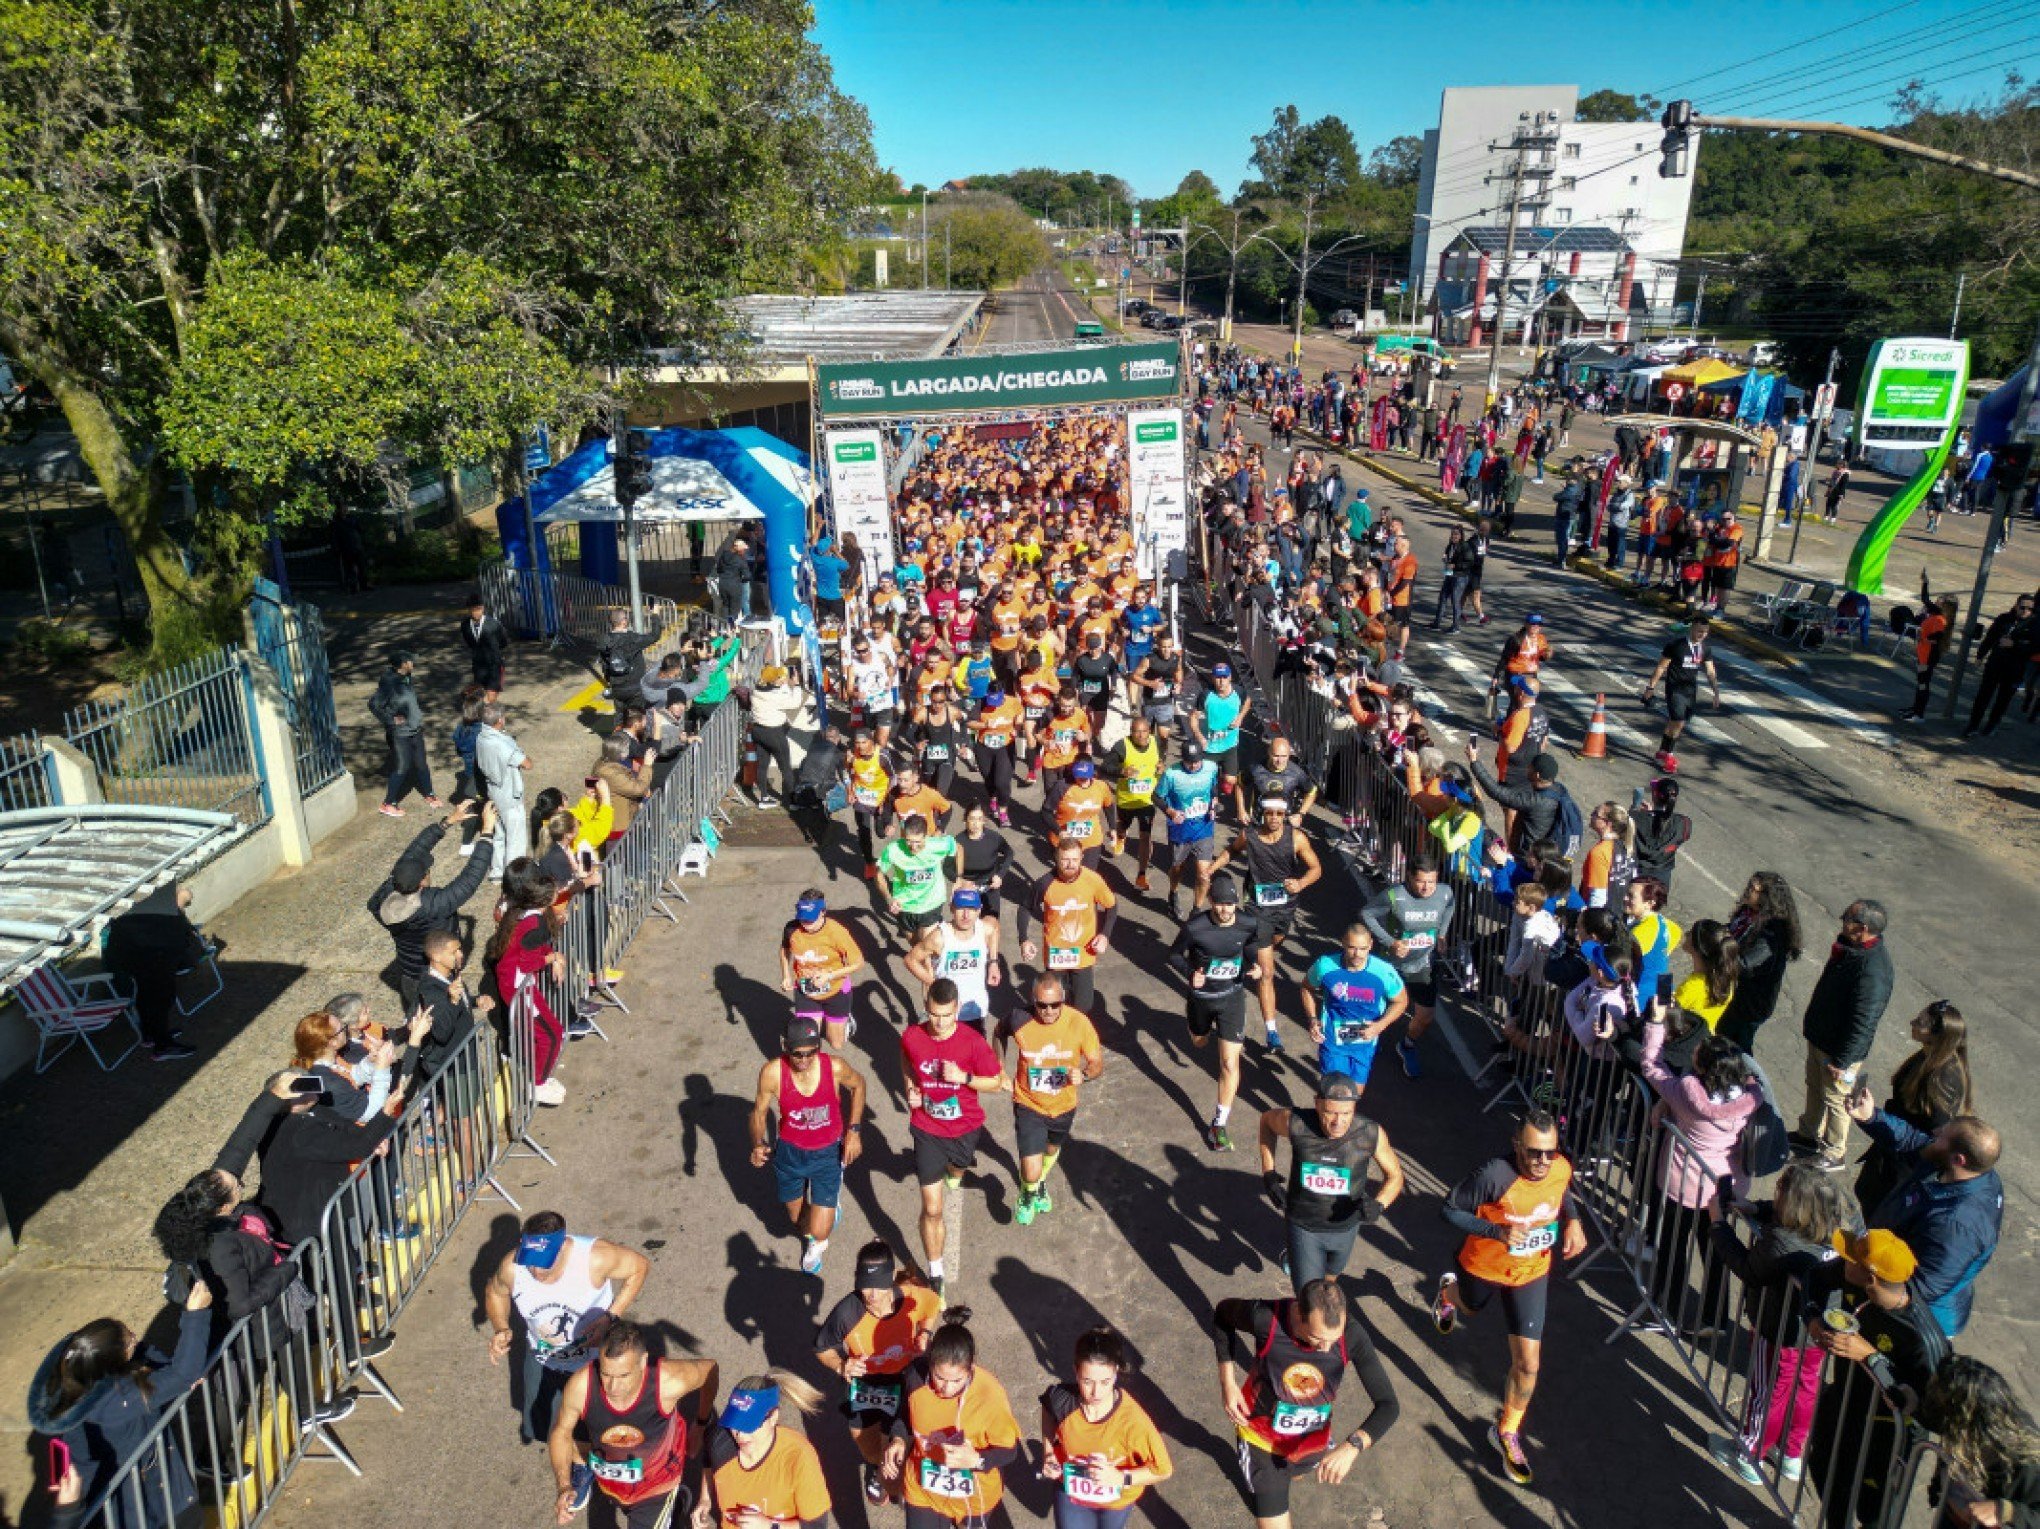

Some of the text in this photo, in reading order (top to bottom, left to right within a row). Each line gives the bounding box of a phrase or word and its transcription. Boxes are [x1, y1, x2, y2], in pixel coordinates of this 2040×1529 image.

[1908, 349, 1953, 361] Sicredi
[891, 367, 1108, 396] LARGADA/CHEGADA
[950, 959, 978, 970] 624
[1305, 1174, 1347, 1190] 1047
[1279, 1415, 1323, 1429] 644
[927, 1471, 972, 1495] 734
